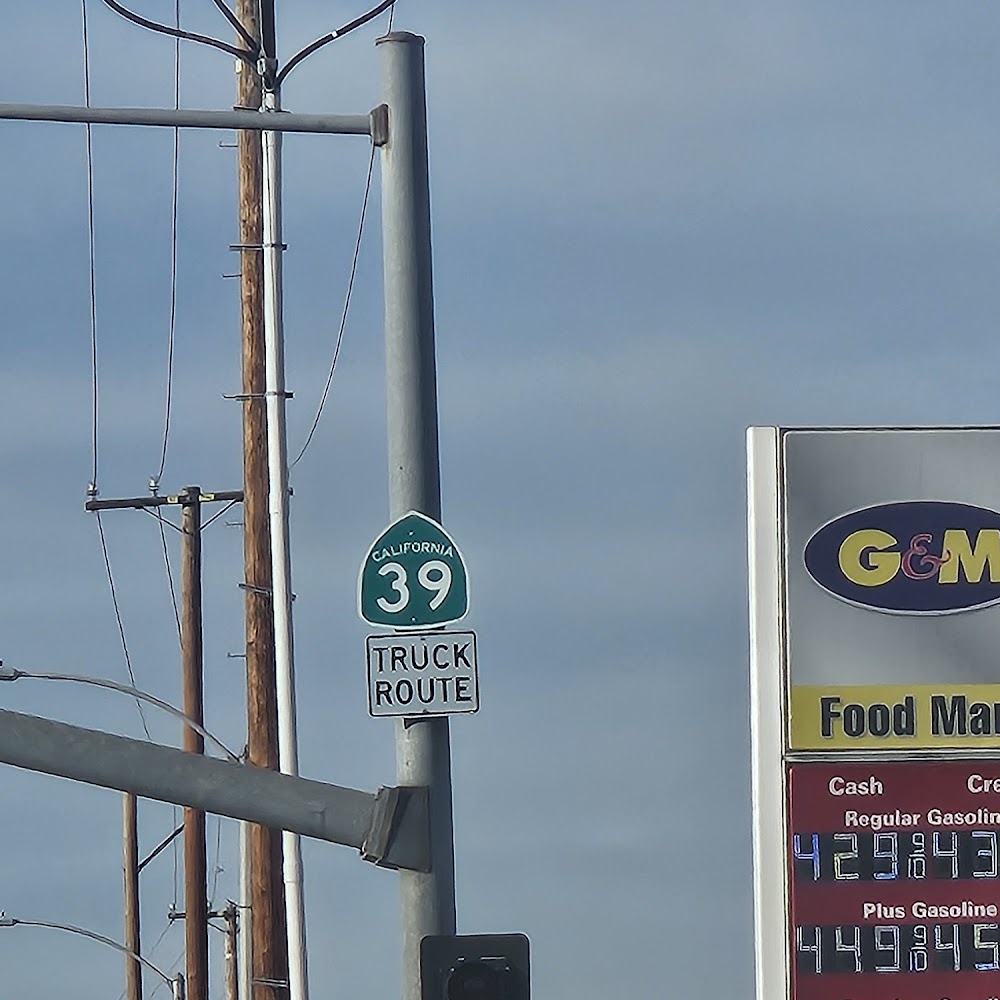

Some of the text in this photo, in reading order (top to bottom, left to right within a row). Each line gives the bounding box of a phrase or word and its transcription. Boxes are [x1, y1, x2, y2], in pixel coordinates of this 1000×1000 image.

[372, 541, 454, 562] CALIFORNIA
[376, 560, 452, 613] 39
[372, 643, 471, 672] TRUCK
[374, 677, 472, 706] ROUTE
[820, 695, 915, 738] Food
[828, 776, 884, 796] Cash
[845, 811, 920, 830] Regular
[863, 901, 998, 919] Plus Gasoline
